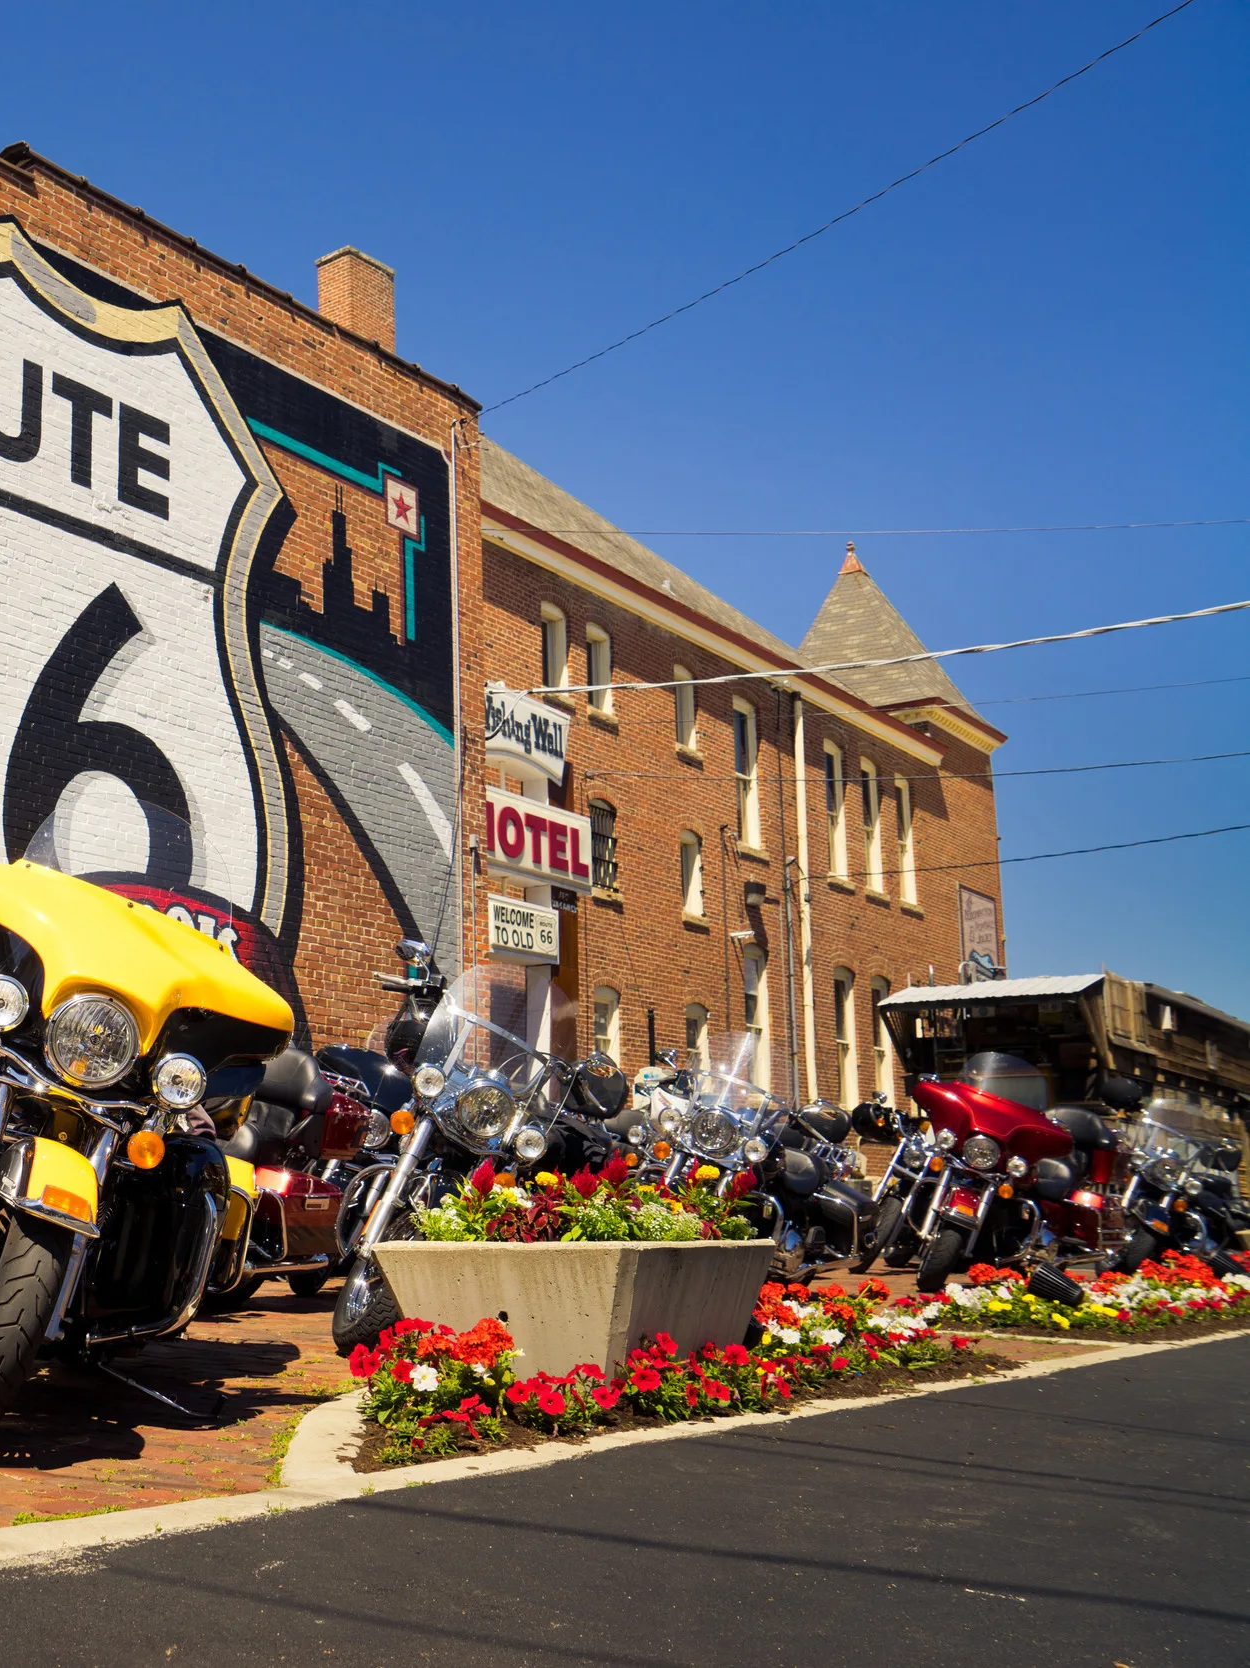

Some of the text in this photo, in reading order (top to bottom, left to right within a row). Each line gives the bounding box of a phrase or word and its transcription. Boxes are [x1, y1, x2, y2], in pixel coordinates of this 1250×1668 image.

[530, 712, 564, 759] Well
[493, 904, 534, 929] WELCOME
[539, 921, 553, 929] ROUTE
[495, 925, 534, 950] TO OLD
[540, 929, 553, 945] 66
